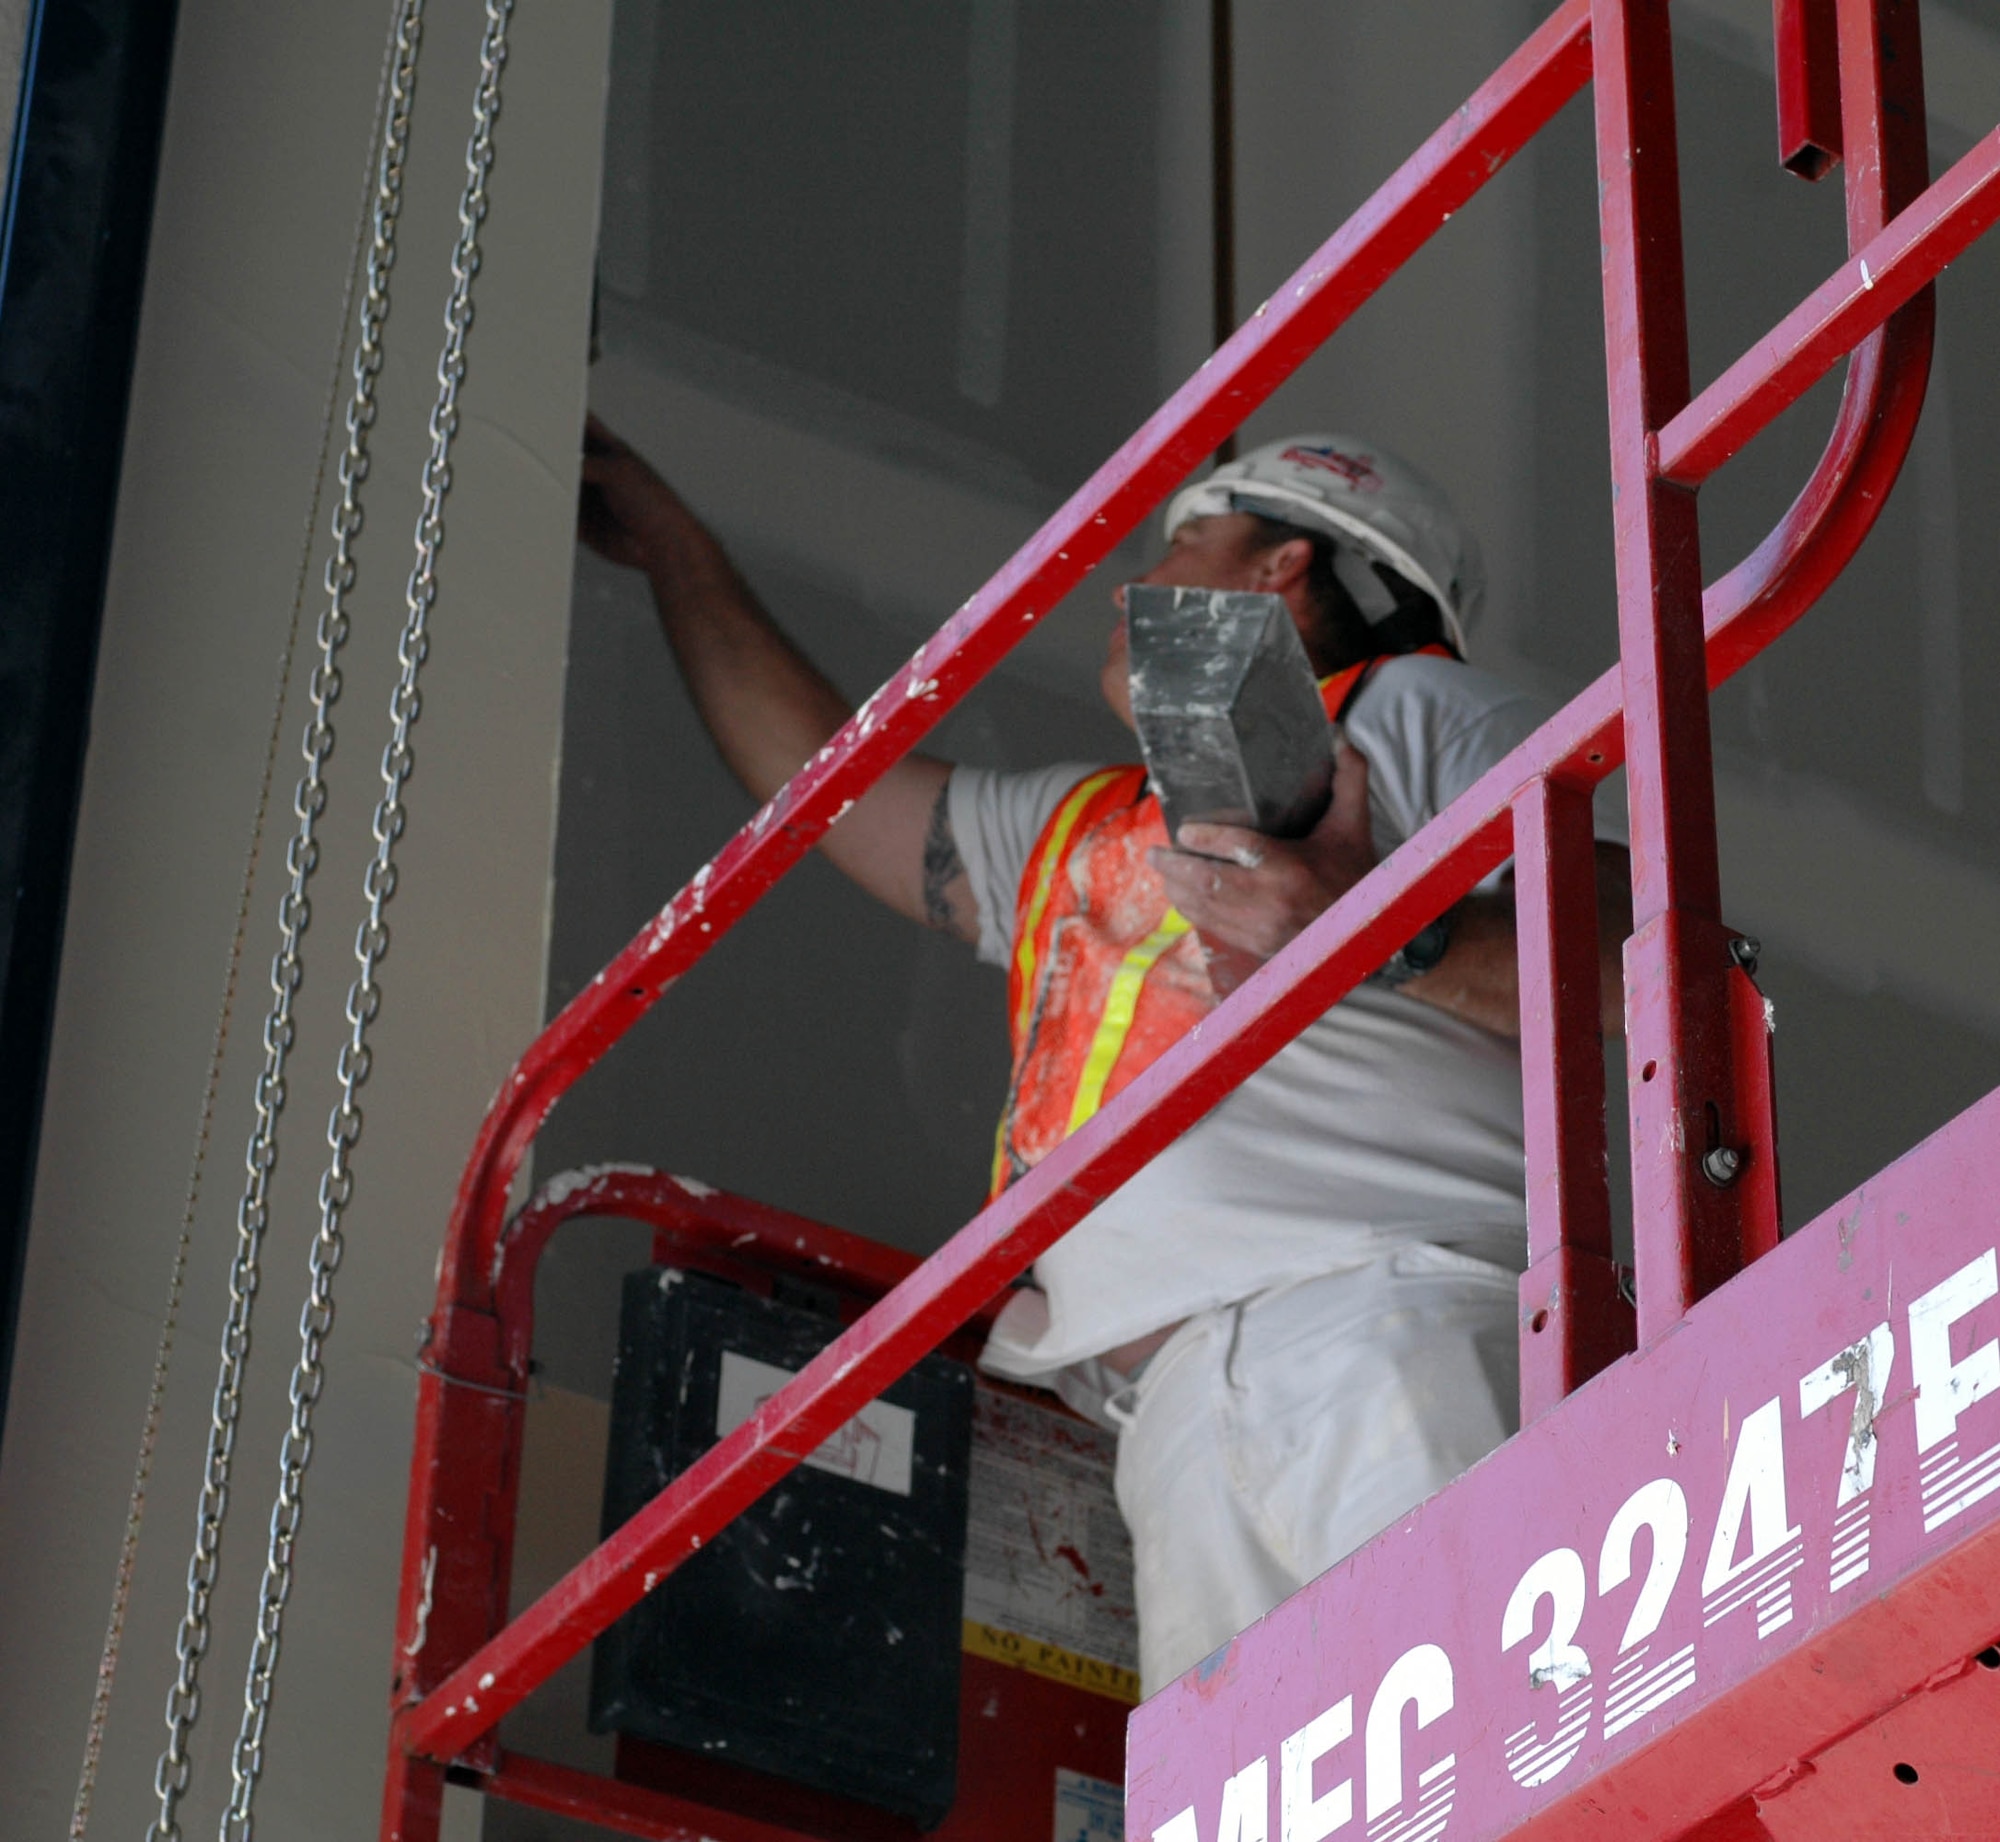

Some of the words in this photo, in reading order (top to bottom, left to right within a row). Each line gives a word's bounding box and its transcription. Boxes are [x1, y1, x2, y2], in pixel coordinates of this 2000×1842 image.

[981, 1625, 1020, 1651] NO
[1151, 1643, 1456, 1842] EC
[1501, 1247, 2000, 1789] 3247E
